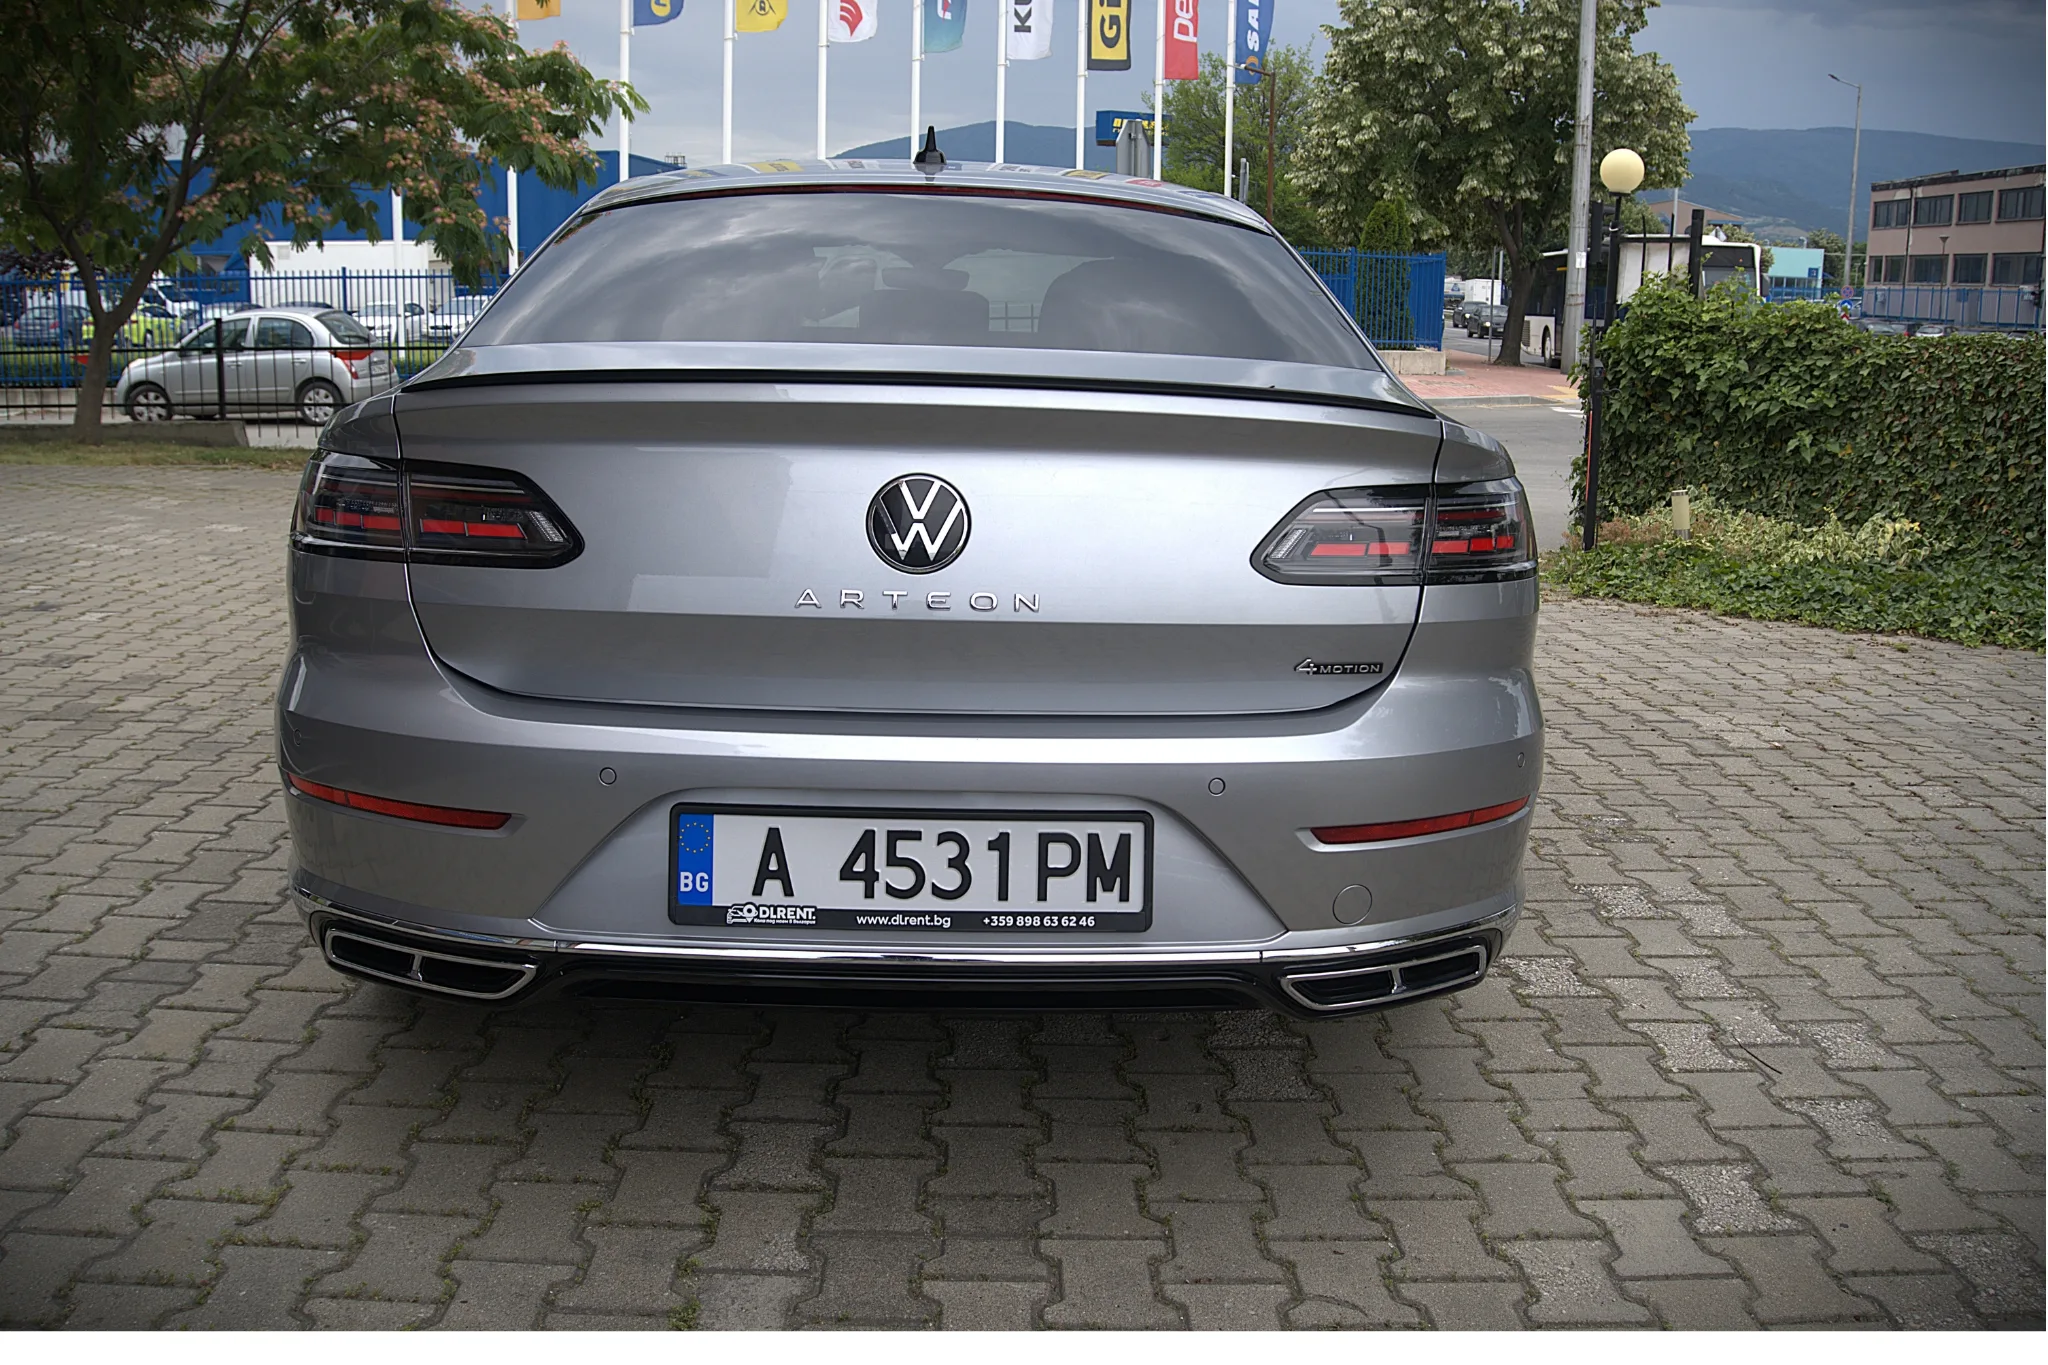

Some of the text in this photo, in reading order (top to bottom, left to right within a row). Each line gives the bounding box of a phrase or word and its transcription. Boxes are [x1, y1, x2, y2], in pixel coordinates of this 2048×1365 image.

[871, 477, 967, 567] VW
[794, 588, 1041, 613] ARTEON
[1294, 658, 1381, 676] 4MOTION
[751, 826, 1132, 902] A 4531 PM
[679, 871, 710, 893] BG
[856, 914, 951, 928] www.dlrent.bg
[983, 916, 1095, 927] +359 898 63 62 46
